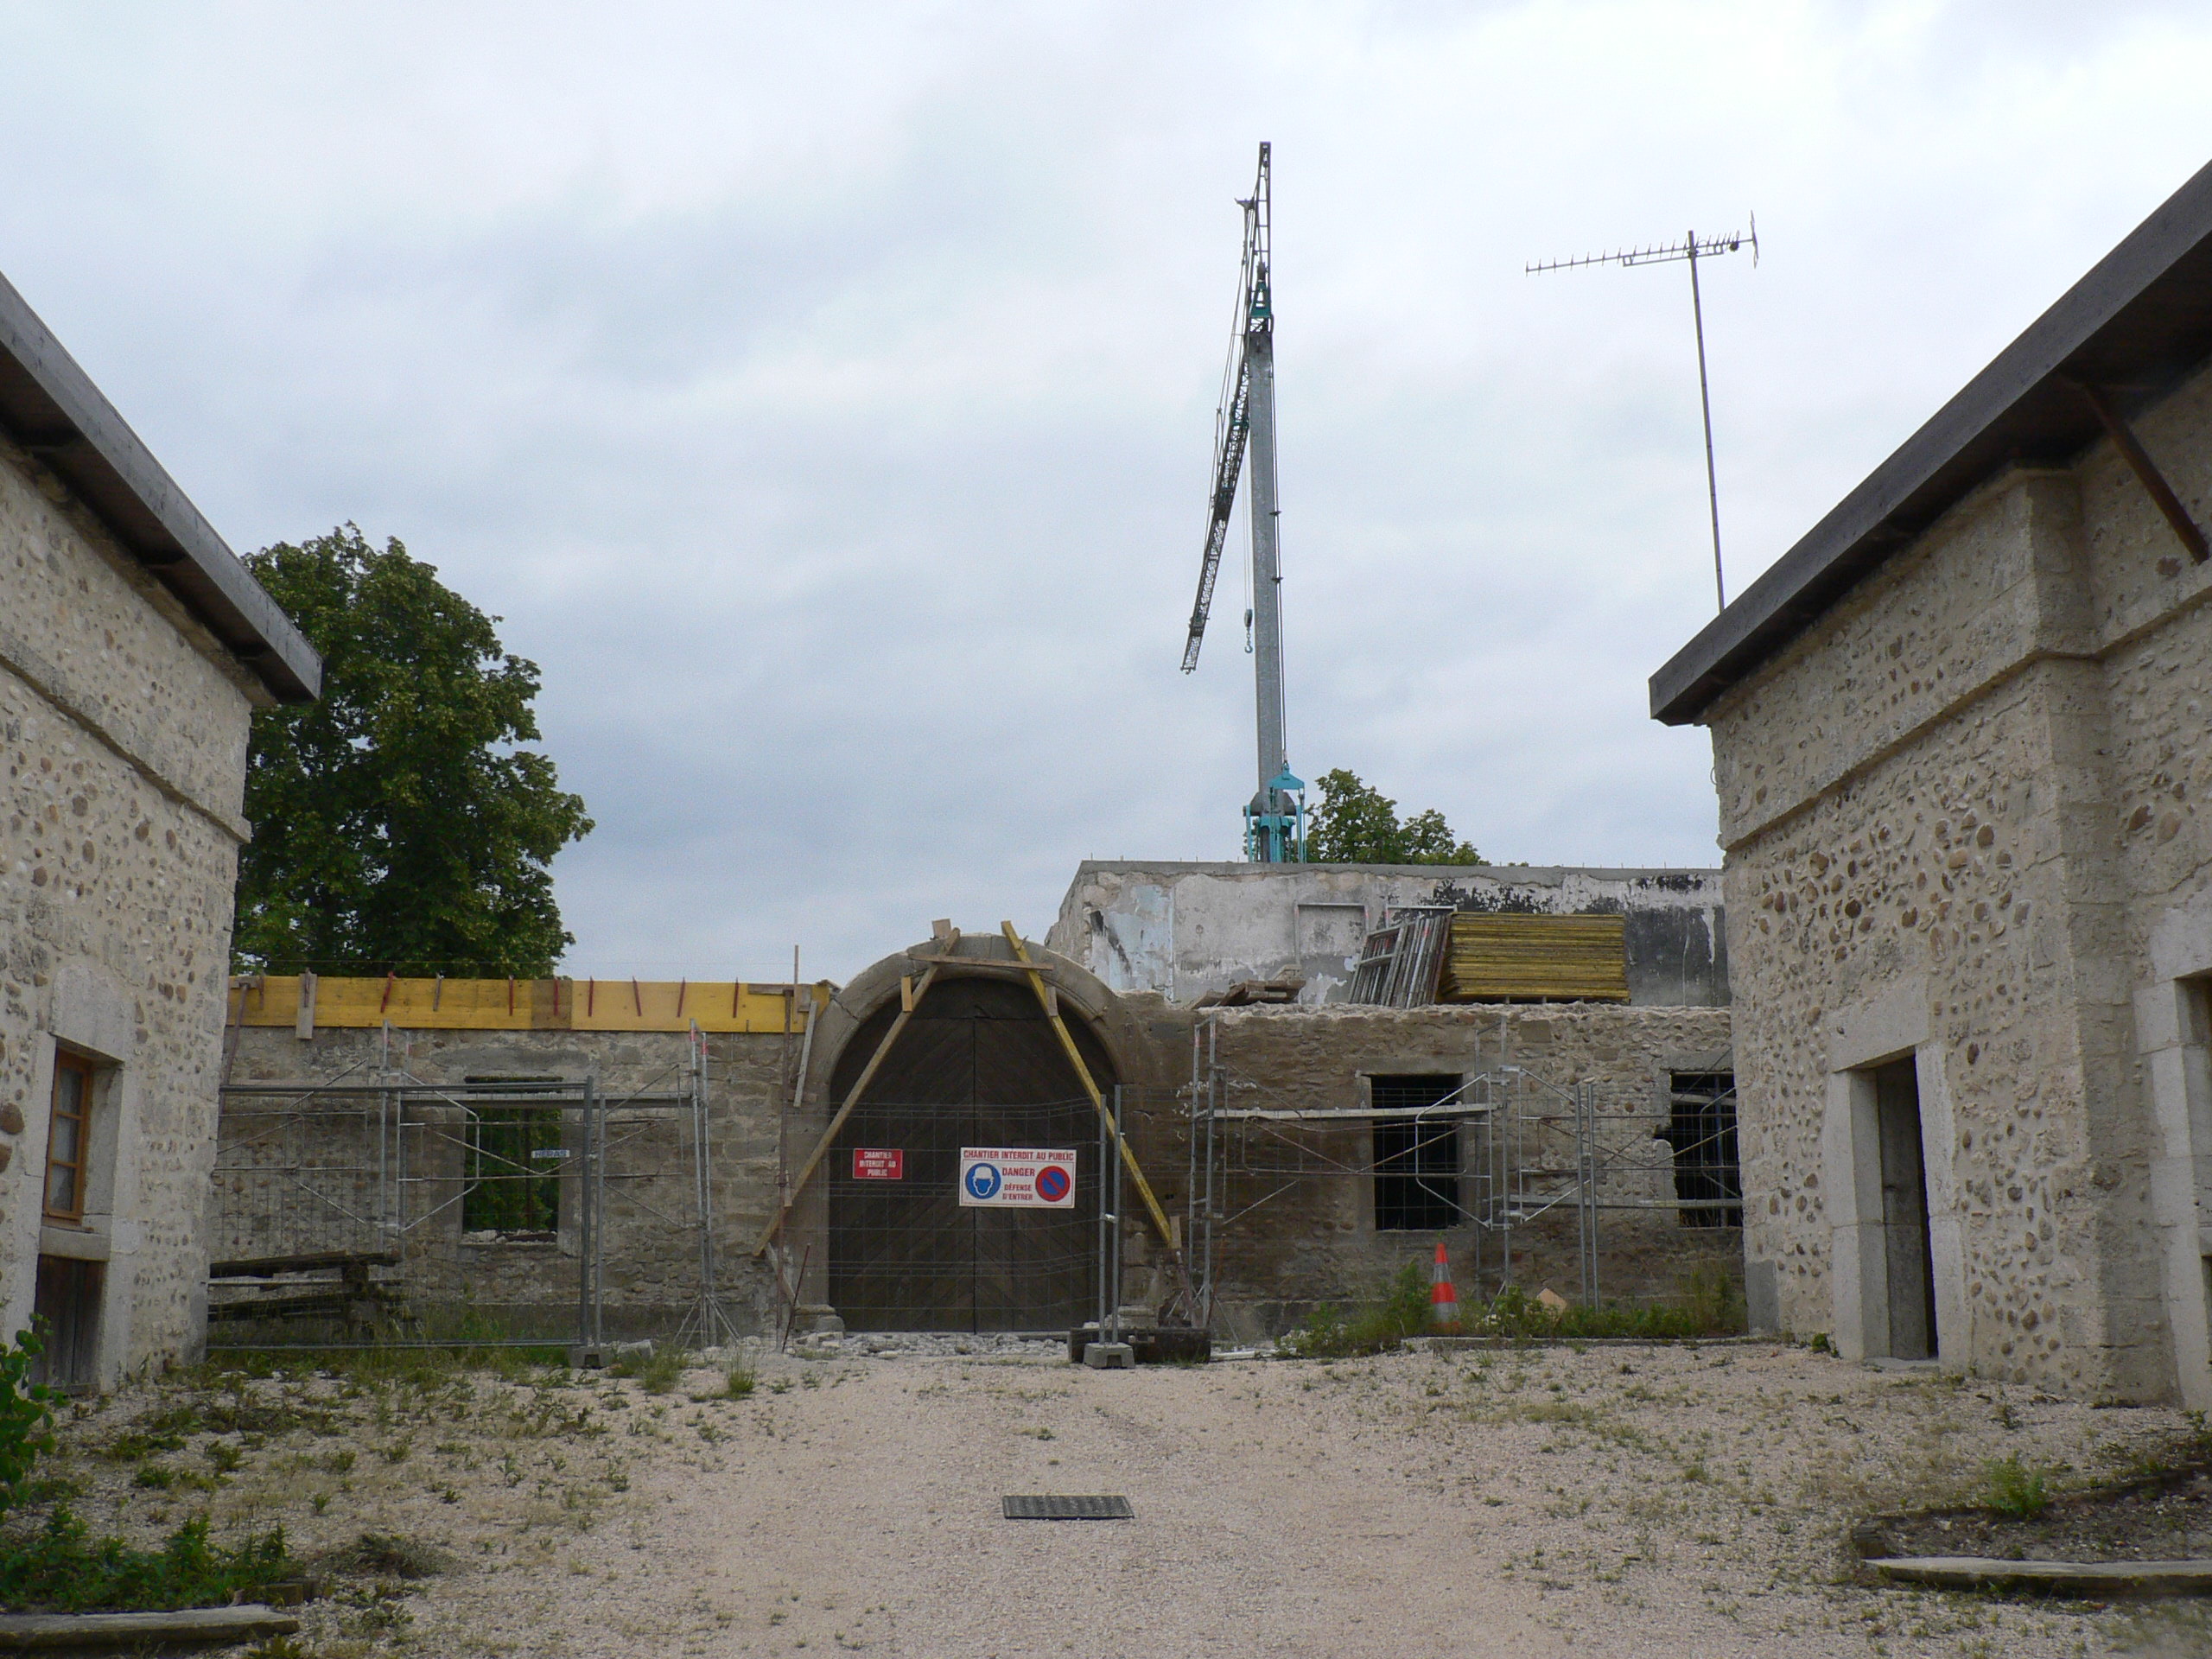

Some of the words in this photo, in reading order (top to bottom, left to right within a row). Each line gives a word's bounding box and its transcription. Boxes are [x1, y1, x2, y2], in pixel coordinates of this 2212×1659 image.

[963, 1150, 999, 1159] CHANTIER
[1001, 1151, 1033, 1160] INTERDIT
[1048, 1152, 1074, 1160] PUBLIC
[1002, 1167, 1035, 1176] DANGER
